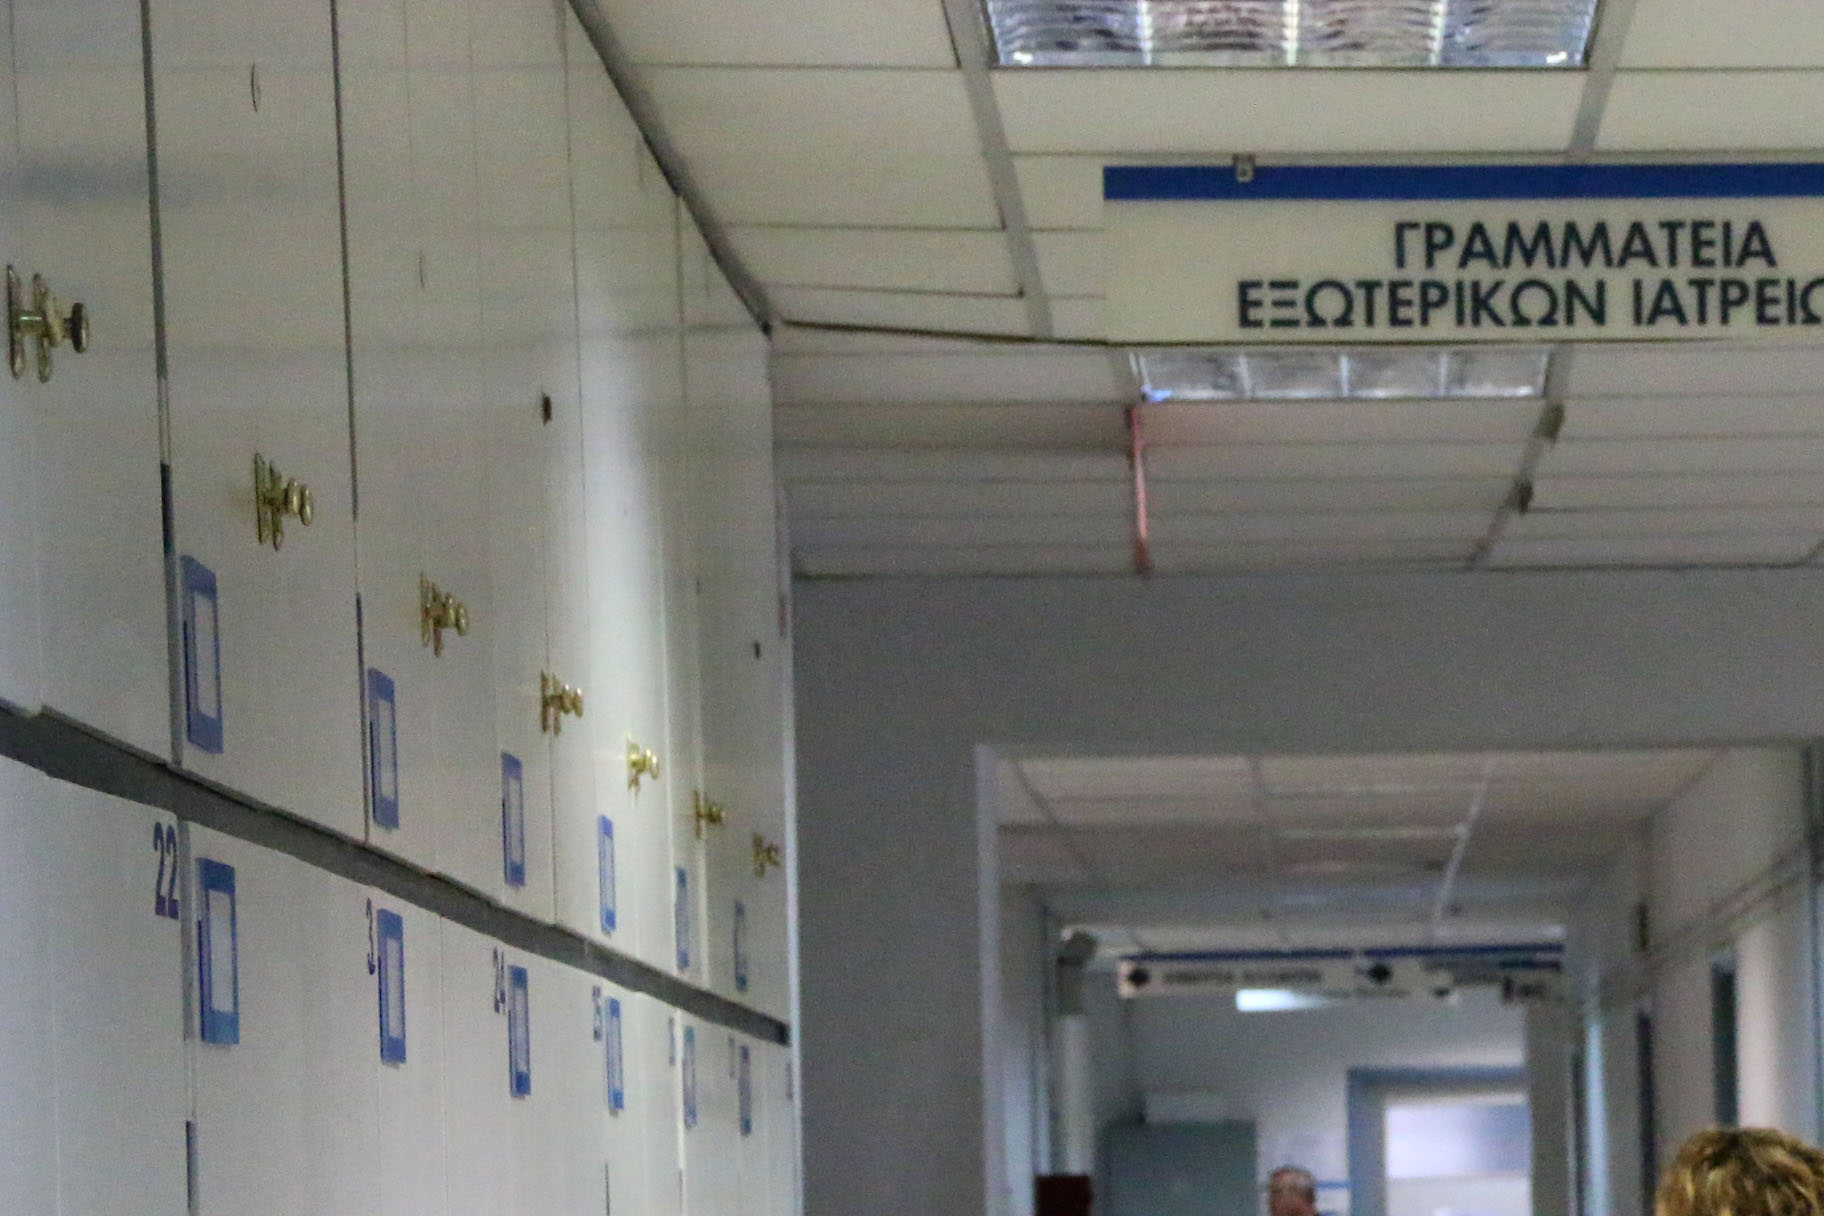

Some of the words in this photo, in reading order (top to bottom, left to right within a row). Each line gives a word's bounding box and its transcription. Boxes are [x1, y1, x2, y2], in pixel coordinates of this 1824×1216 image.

[1394, 220, 1777, 269] ΓΡΑΜΜΑΤΕΙΑ
[1237, 278, 1606, 328] ΕΞΩΤΕΡΙΚΩΝ
[152, 821, 179, 920] 22
